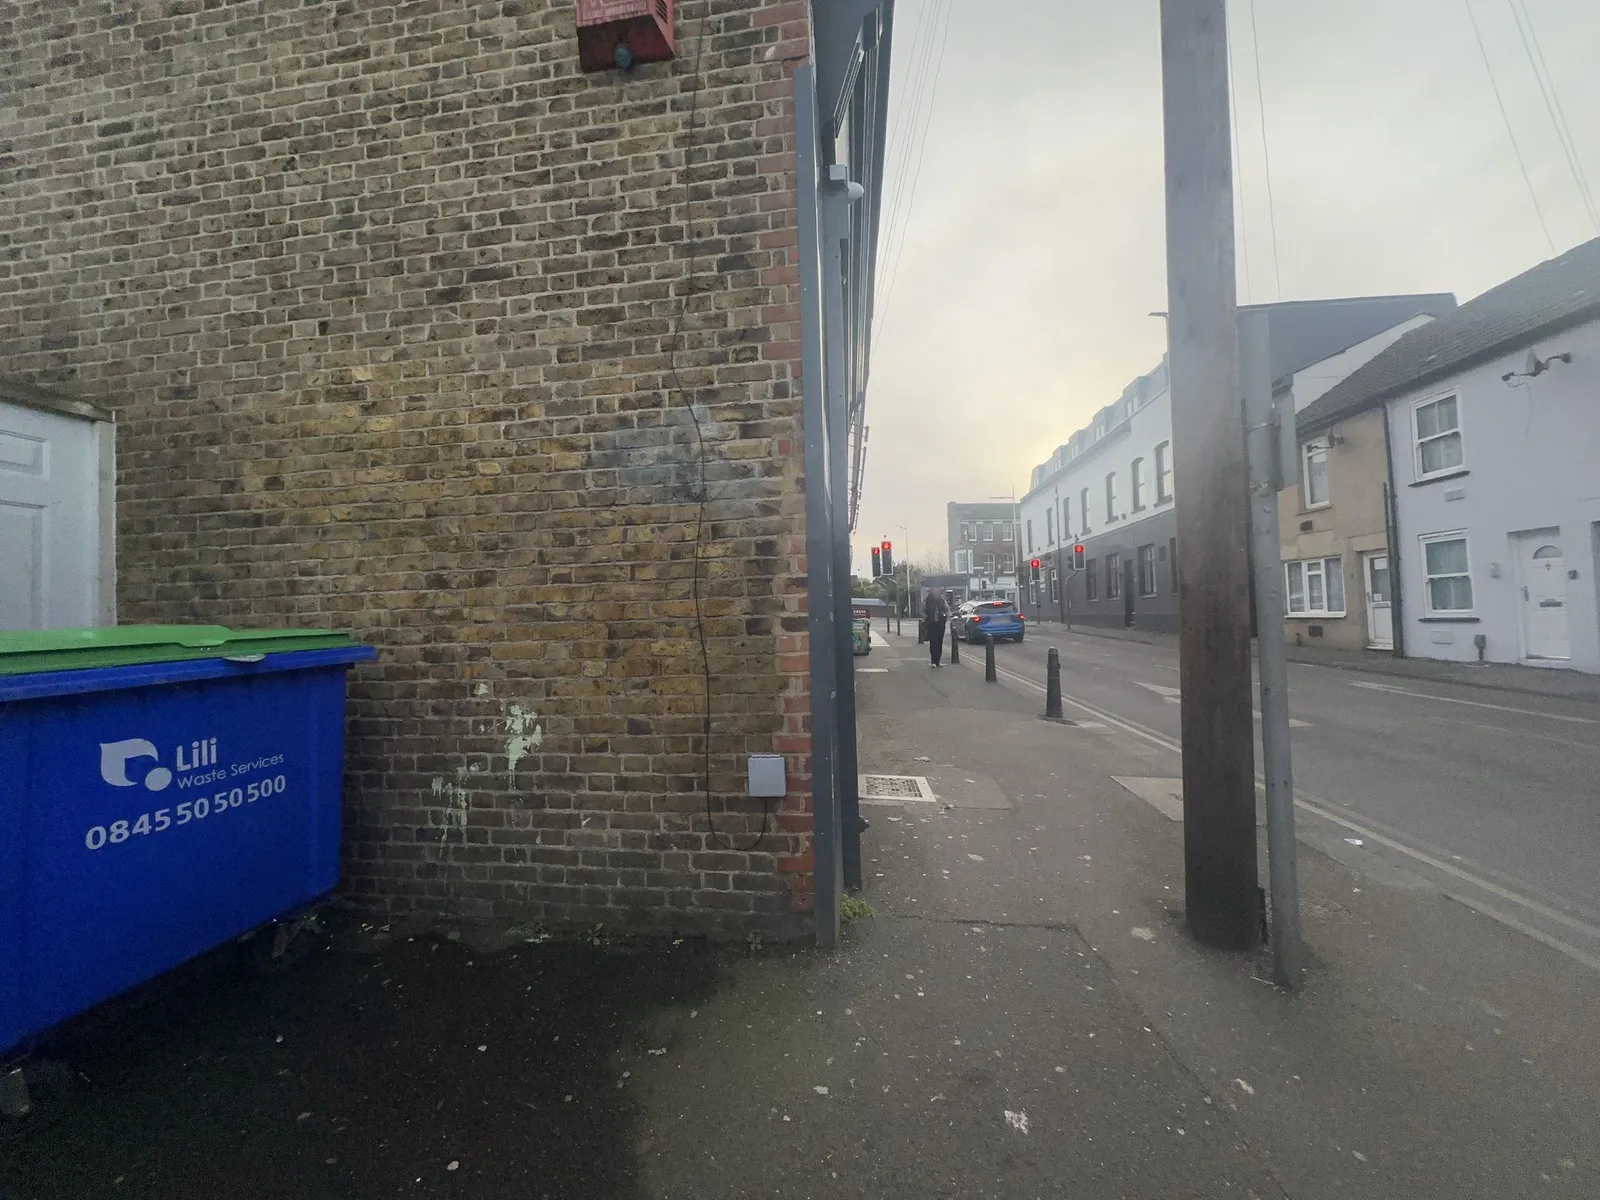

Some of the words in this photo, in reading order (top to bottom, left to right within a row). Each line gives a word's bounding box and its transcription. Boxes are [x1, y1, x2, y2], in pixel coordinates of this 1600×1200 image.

[176, 737, 217, 772] Lili
[177, 767, 227, 789] Waste
[230, 753, 284, 776] Services
[85, 808, 171, 850] 0845
[176, 797, 210, 825] 50
[214, 787, 243, 813] 50
[247, 775, 286, 803] 500
